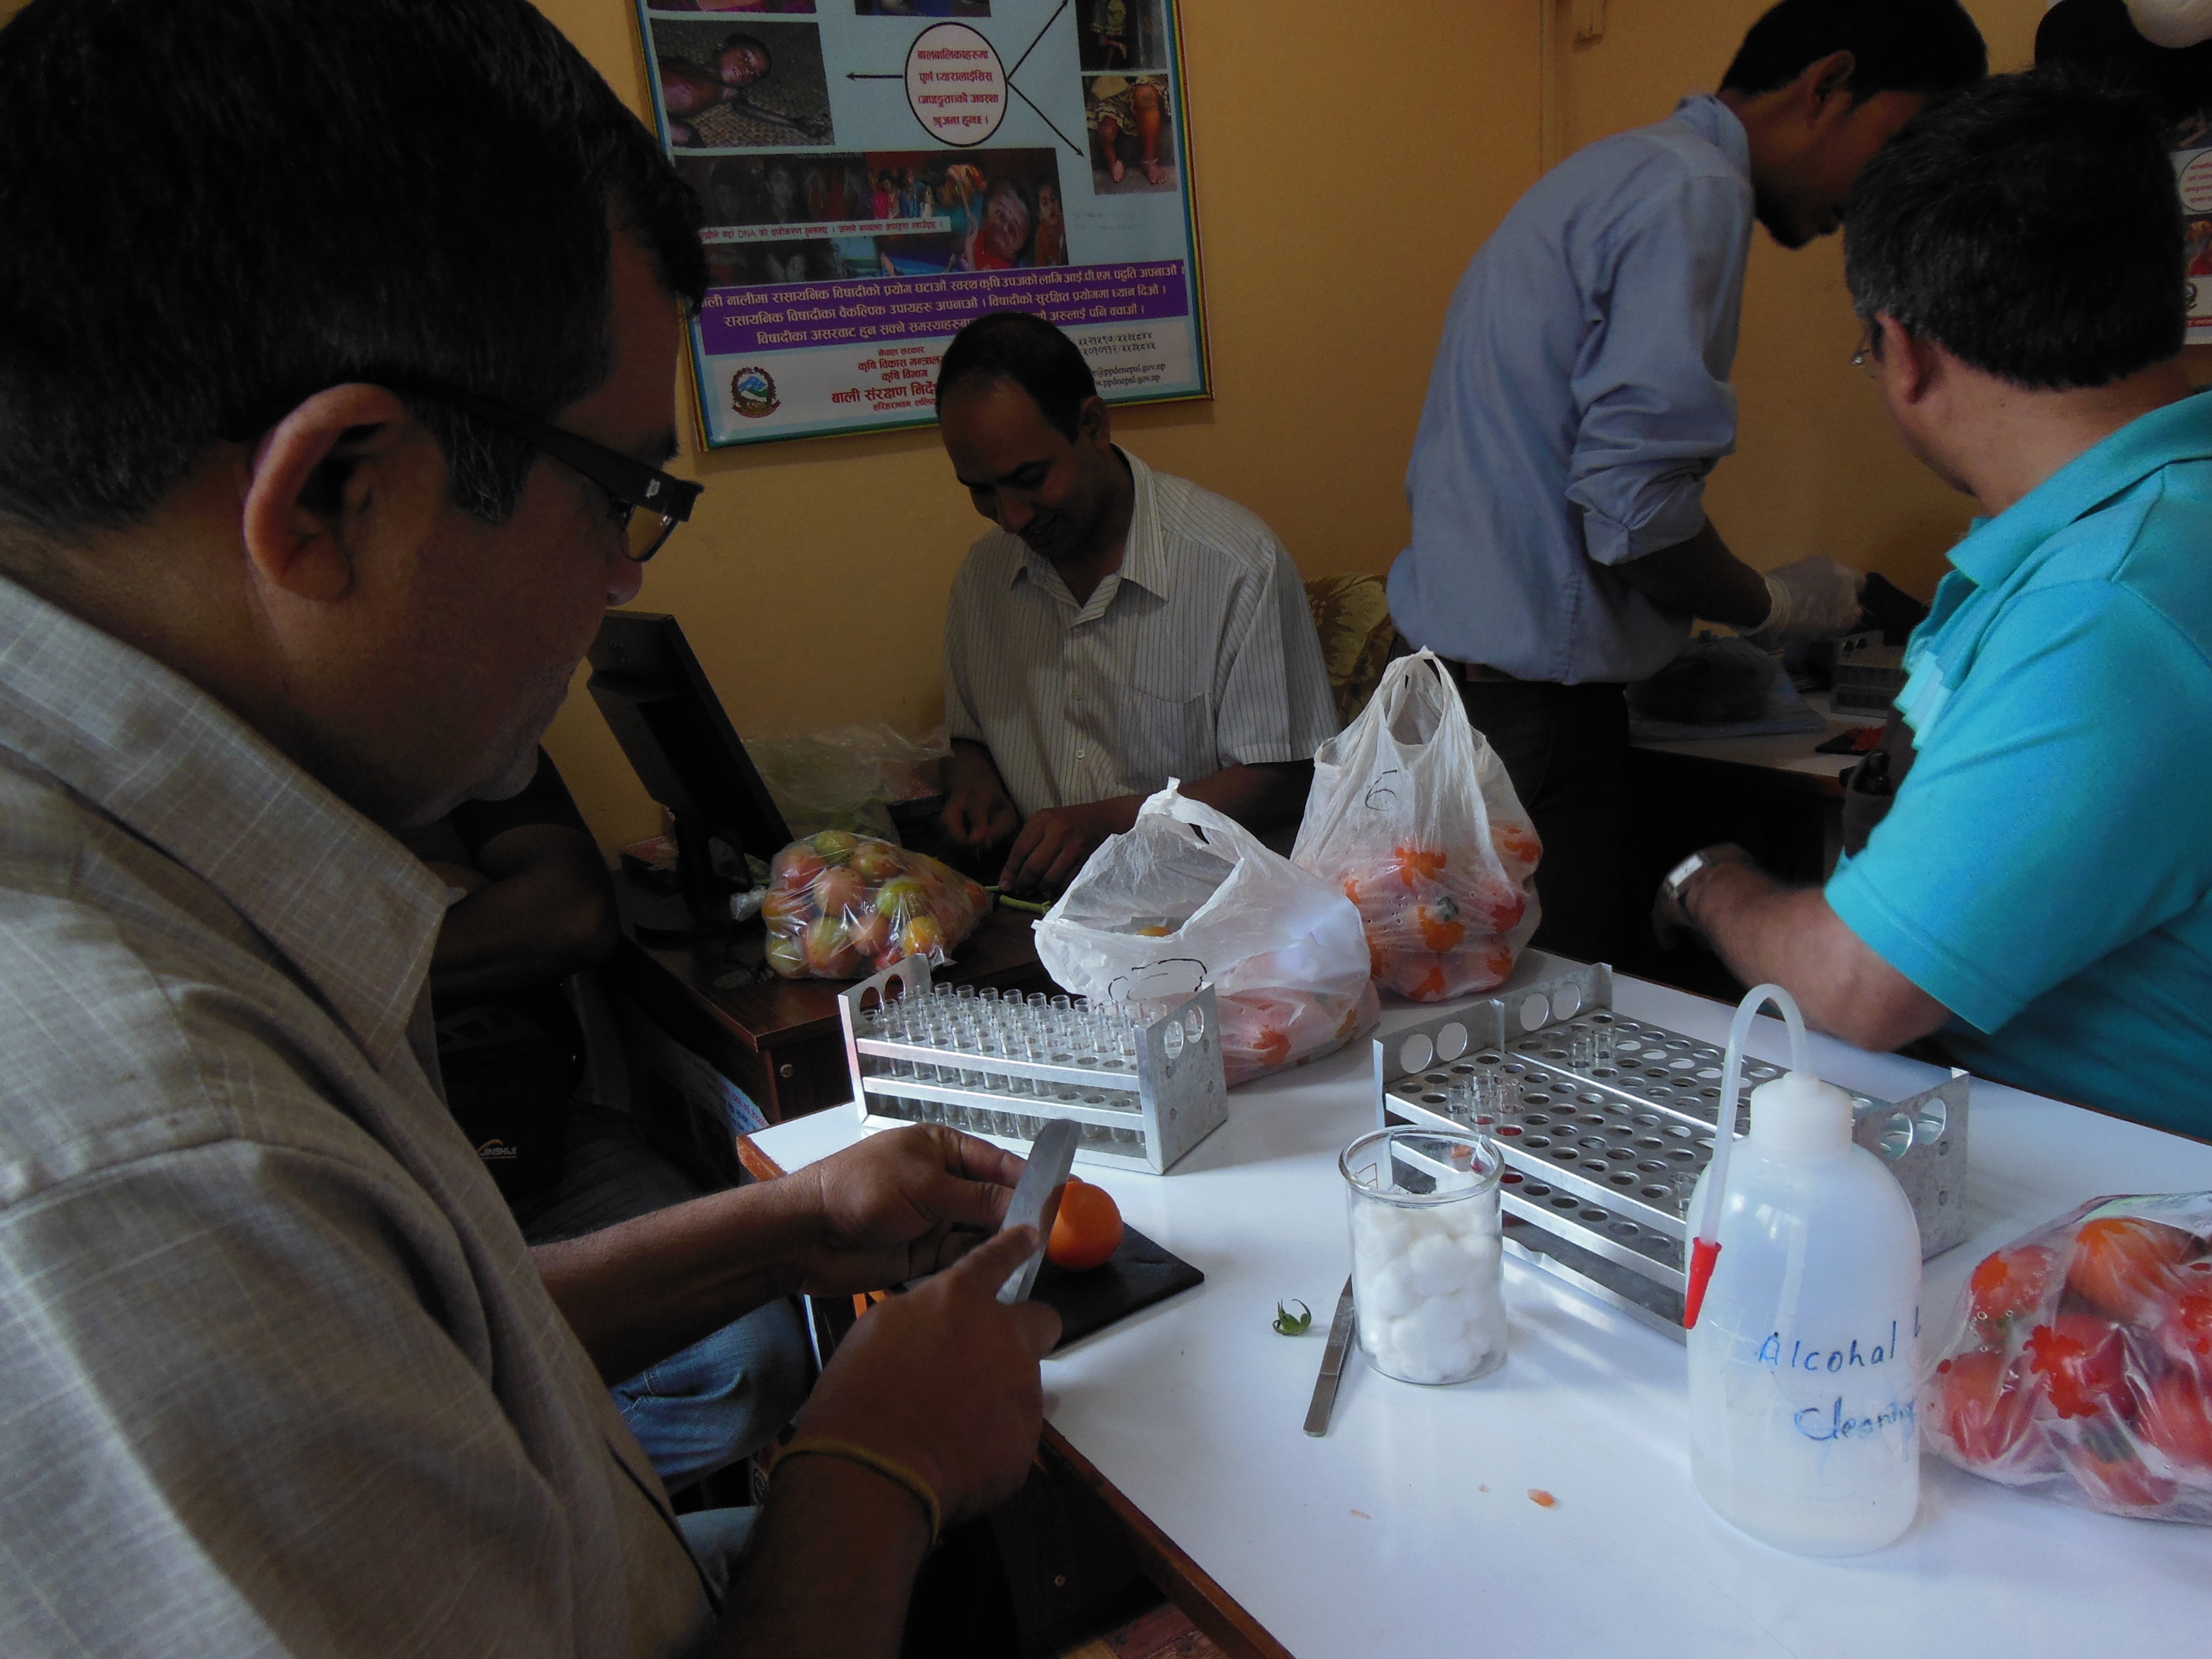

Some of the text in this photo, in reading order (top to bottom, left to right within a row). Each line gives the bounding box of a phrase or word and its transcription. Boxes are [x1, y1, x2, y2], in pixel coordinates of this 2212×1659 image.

[970, 94, 998, 103] अवस्था
[726, 292, 768, 306] नालीमा
[771, 288, 830, 304] रासायनिक
[833, 283, 880, 299] विषादीको
[884, 282, 912, 297] प्रयोग
[951, 279, 978, 291] स्वस्थ
[979, 275, 1000, 291] कृषि
[723, 311, 784, 327] रासायनिक
[787, 308, 836, 322] विषादीका
[839, 304, 886, 318] वैकल्पिक
[989, 292, 1033, 307] विषादीको
[1036, 290, 1069, 306] सुरक्षित
[1073, 288, 1109, 302] प्रयोगमा
[1112, 287, 1135, 298] ध्यान
[757, 329, 807, 344] विषादीका
[859, 325, 876, 338] हुन
[880, 321, 905, 335] सक्ने
[1089, 306, 1107, 318] पनि
[878, 346, 924, 356] नेपाल सरकार
[858, 359, 876, 372] कृषि
[880, 359, 907, 369] विकास
[1092, 363, 1166, 377] r@ppdenepal.gov.np
[882, 369, 928, 382] कृषि विभाग
[1095, 375, 1160, 388] w.ppdnepal.gov.np
[832, 388, 861, 403] बाली
[864, 386, 907, 401] संरक्षण
